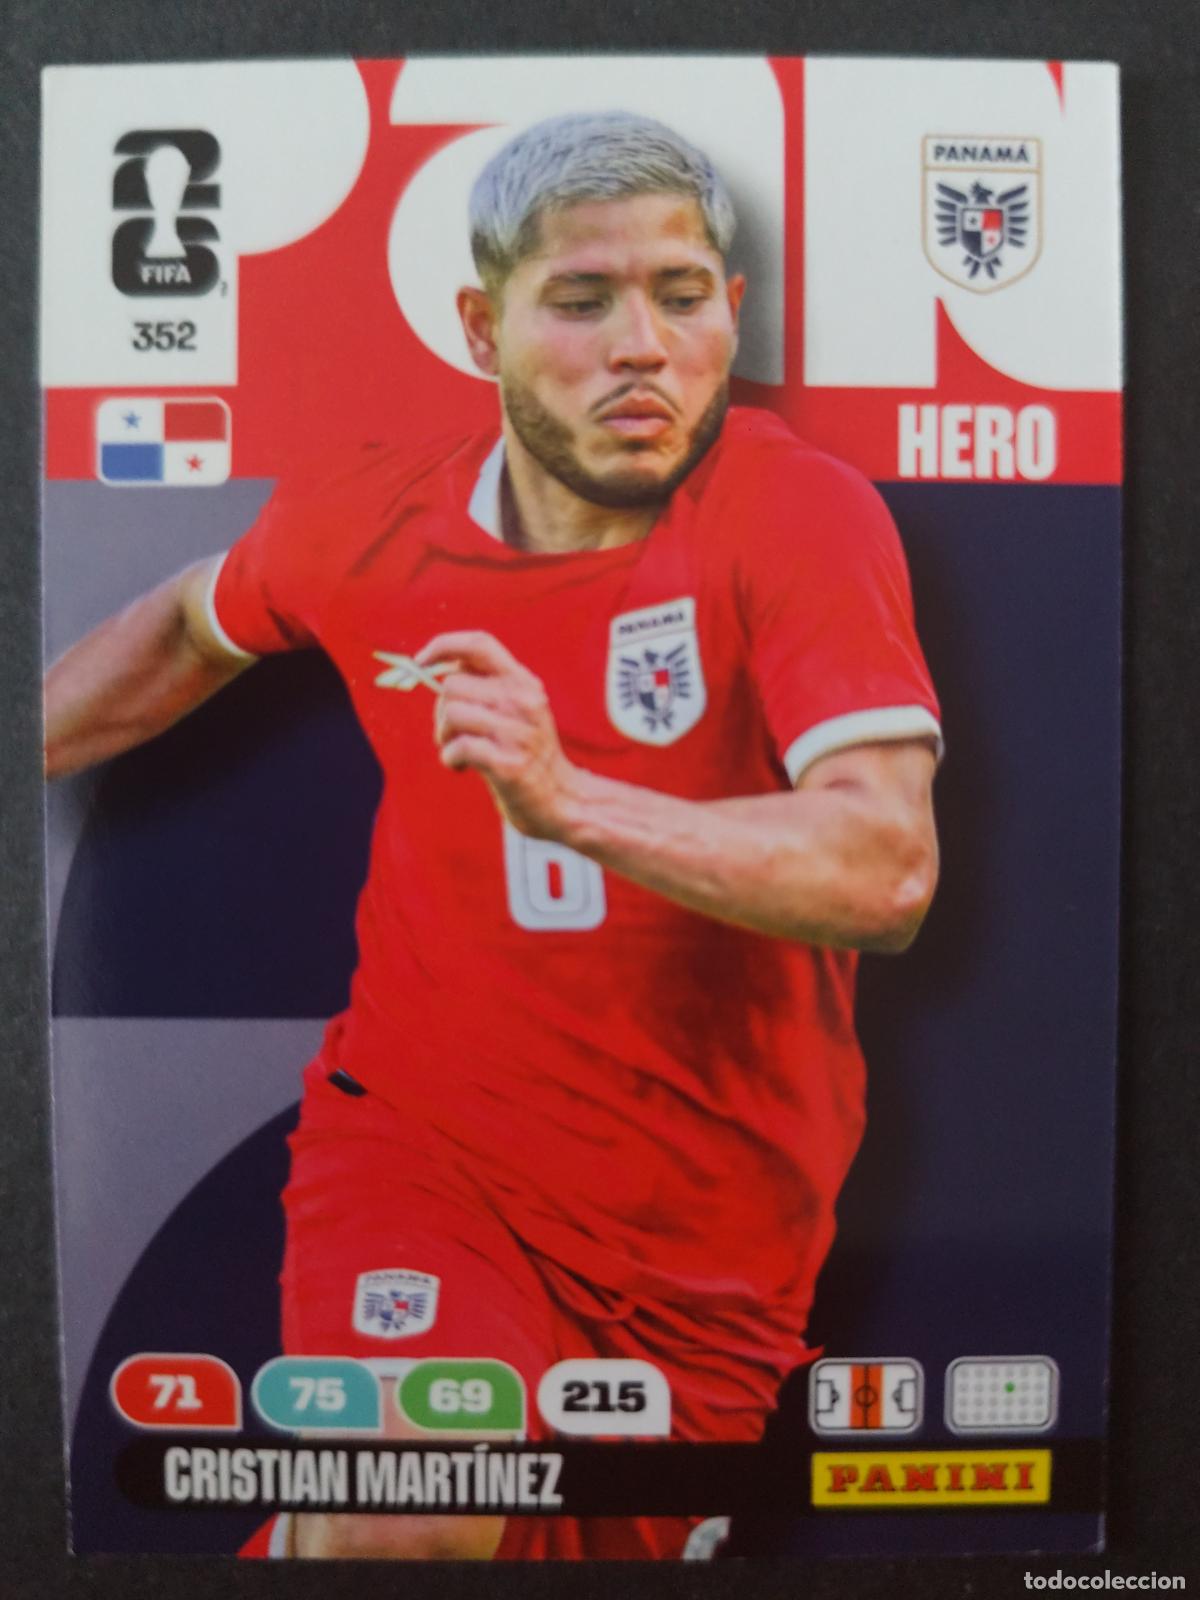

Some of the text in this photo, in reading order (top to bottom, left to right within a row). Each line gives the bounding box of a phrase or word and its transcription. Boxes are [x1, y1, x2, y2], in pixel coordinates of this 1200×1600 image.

[933, 144, 1030, 163] PANAMÁ
[139, 263, 192, 284] FIFA
[132, 321, 197, 352] 352
[898, 402, 1057, 481] HERO
[148, 1374, 203, 1411] 71
[288, 1376, 347, 1412] 75
[428, 1377, 494, 1414] 69
[561, 1380, 648, 1414] 215
[163, 1443, 564, 1508] CRISTIAN MARTÍNEZ
[826, 1461, 1036, 1494] PANINI
